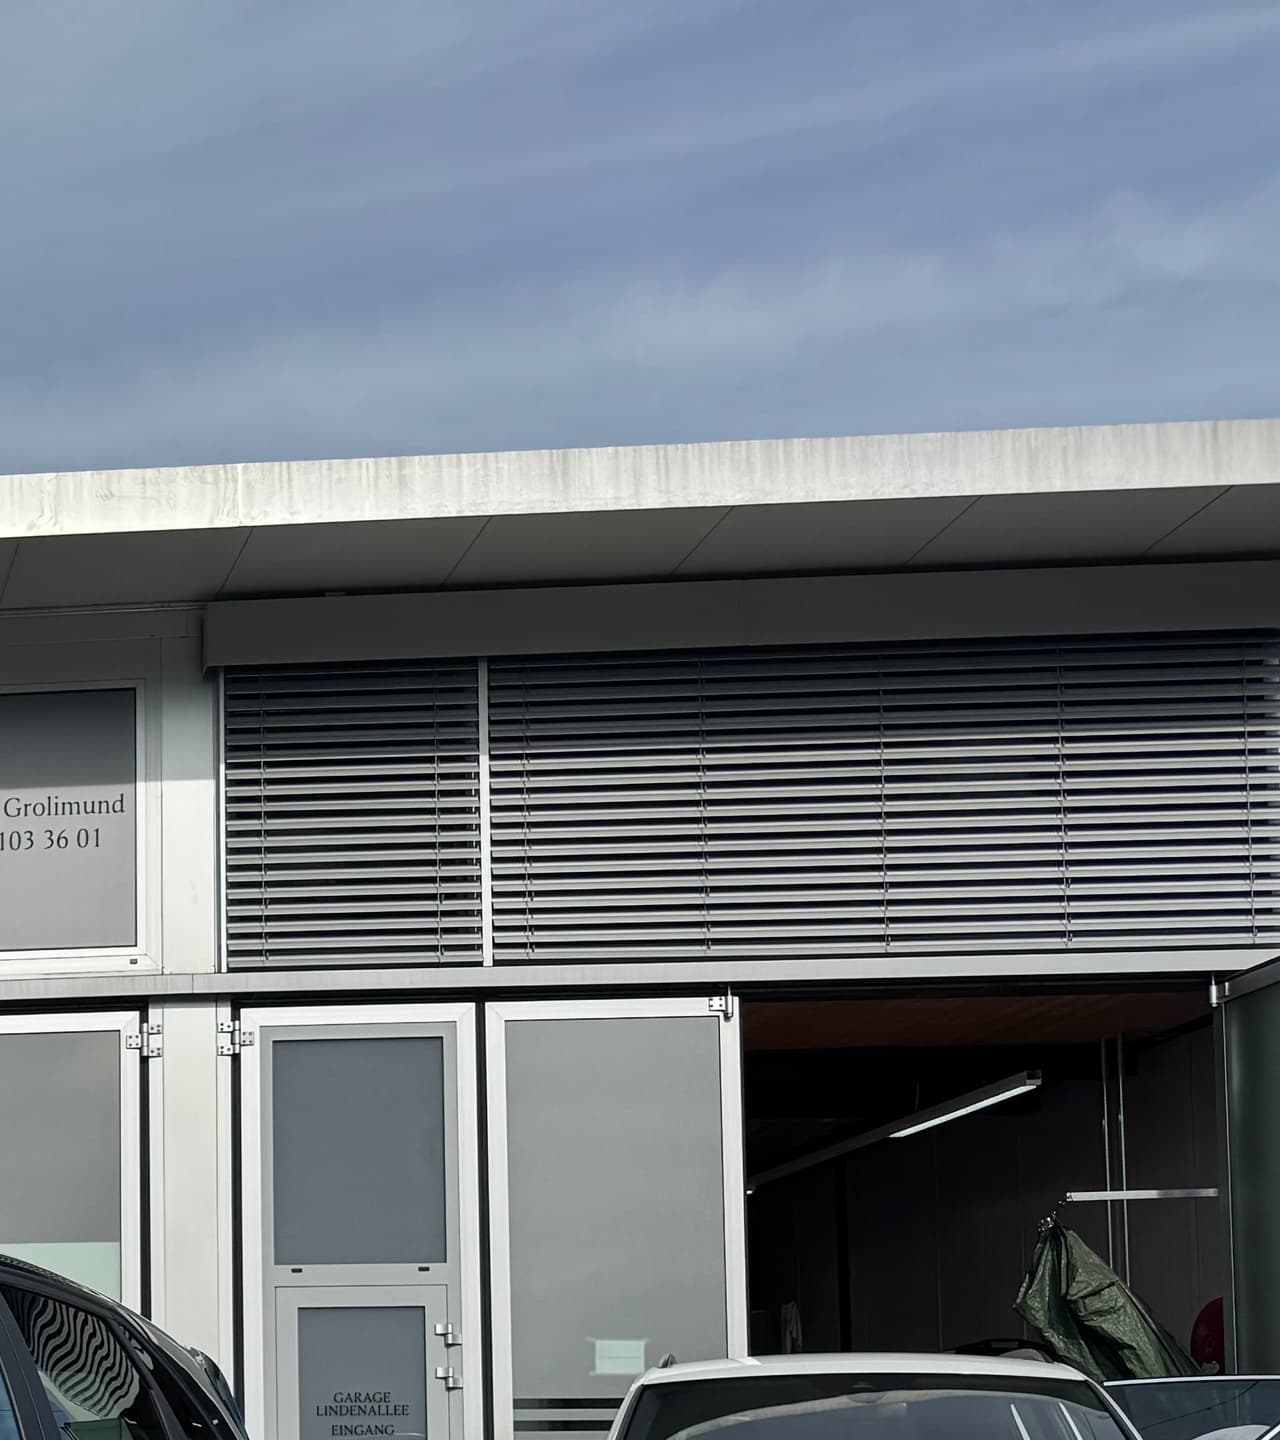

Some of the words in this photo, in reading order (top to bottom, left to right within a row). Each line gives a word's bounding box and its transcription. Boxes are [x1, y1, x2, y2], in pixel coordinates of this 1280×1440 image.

[2, 793, 127, 819] Grolimund
[42, 827, 70, 850] 36
[75, 826, 102, 849] 01
[333, 1391, 391, 1404] GARAGE
[316, 1404, 410, 1417] LINDENALLEE
[331, 1424, 395, 1437] EINGANG
